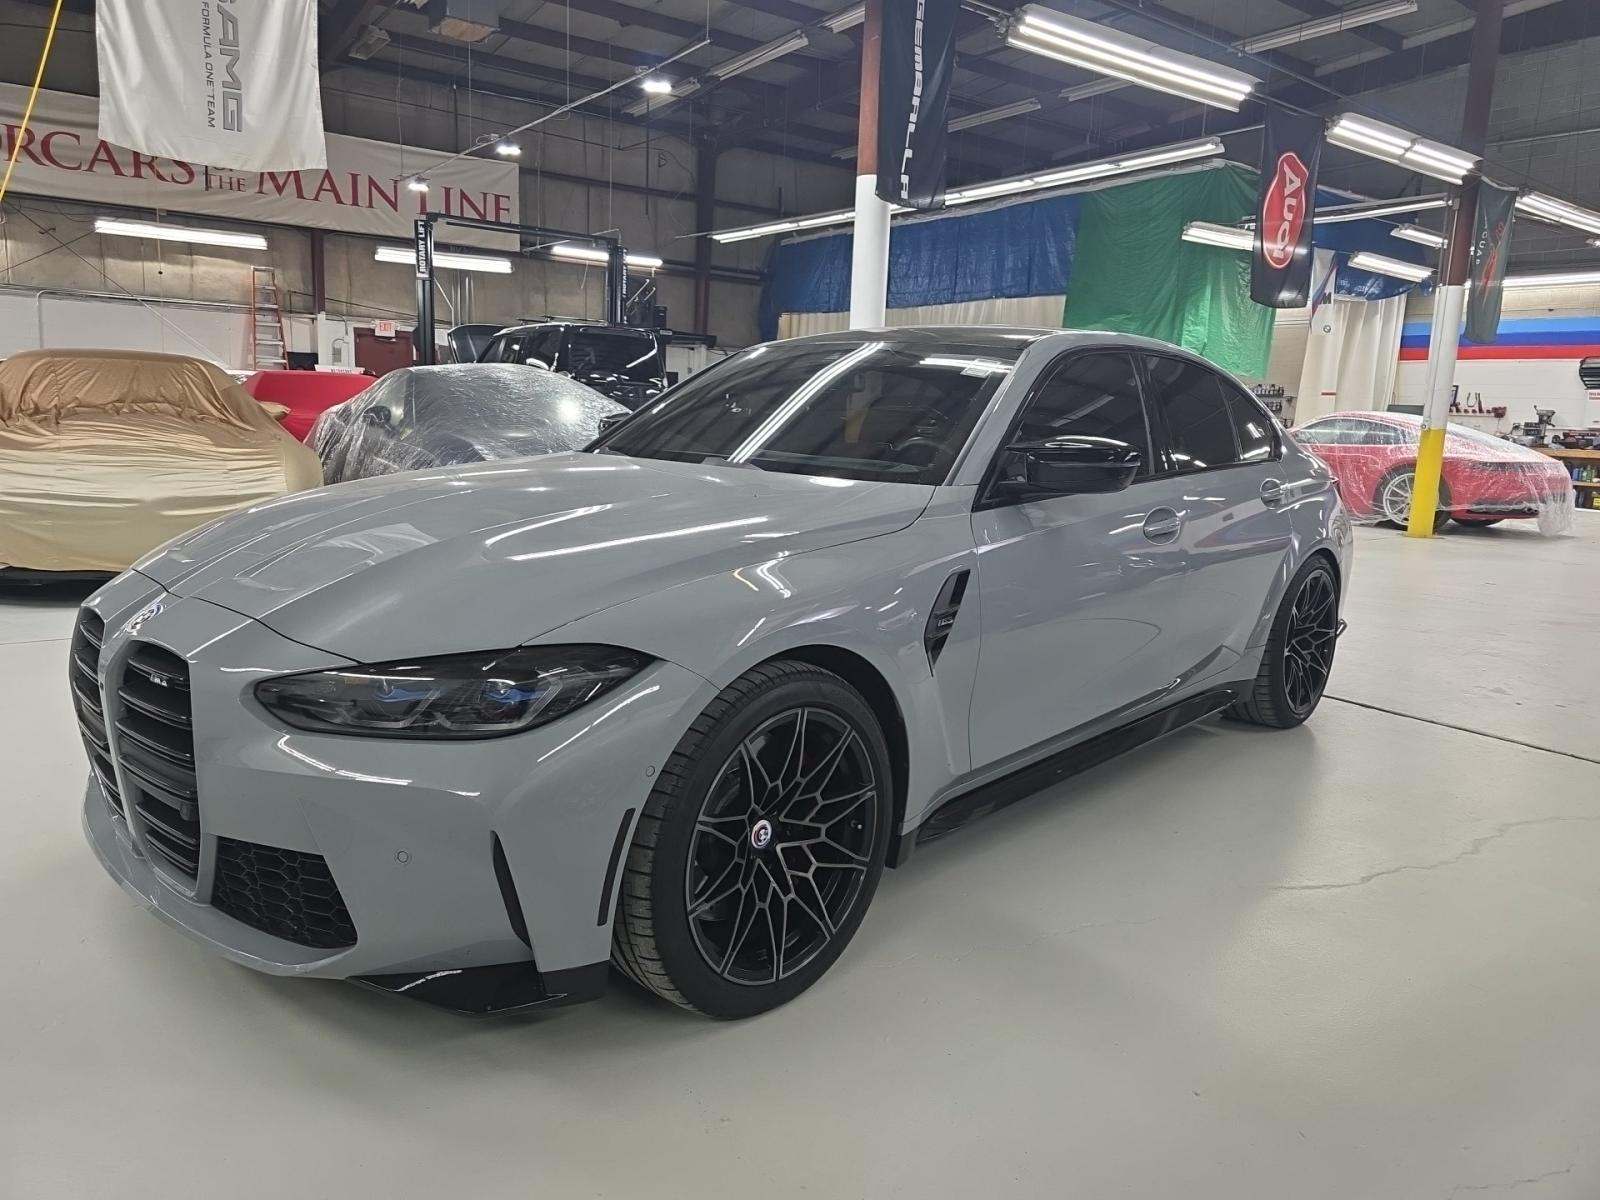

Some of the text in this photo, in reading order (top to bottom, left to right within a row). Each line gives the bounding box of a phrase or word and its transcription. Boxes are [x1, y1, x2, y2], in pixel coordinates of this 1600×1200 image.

[201, 1, 216, 128] FORMULA ONE TEAM
[217, 2, 242, 132] AMG
[0, 123, 195, 185] RCARS
[204, 173, 247, 192] THE
[255, 169, 401, 212] MAIN
[417, 221, 427, 273] ROTARY LIFT
